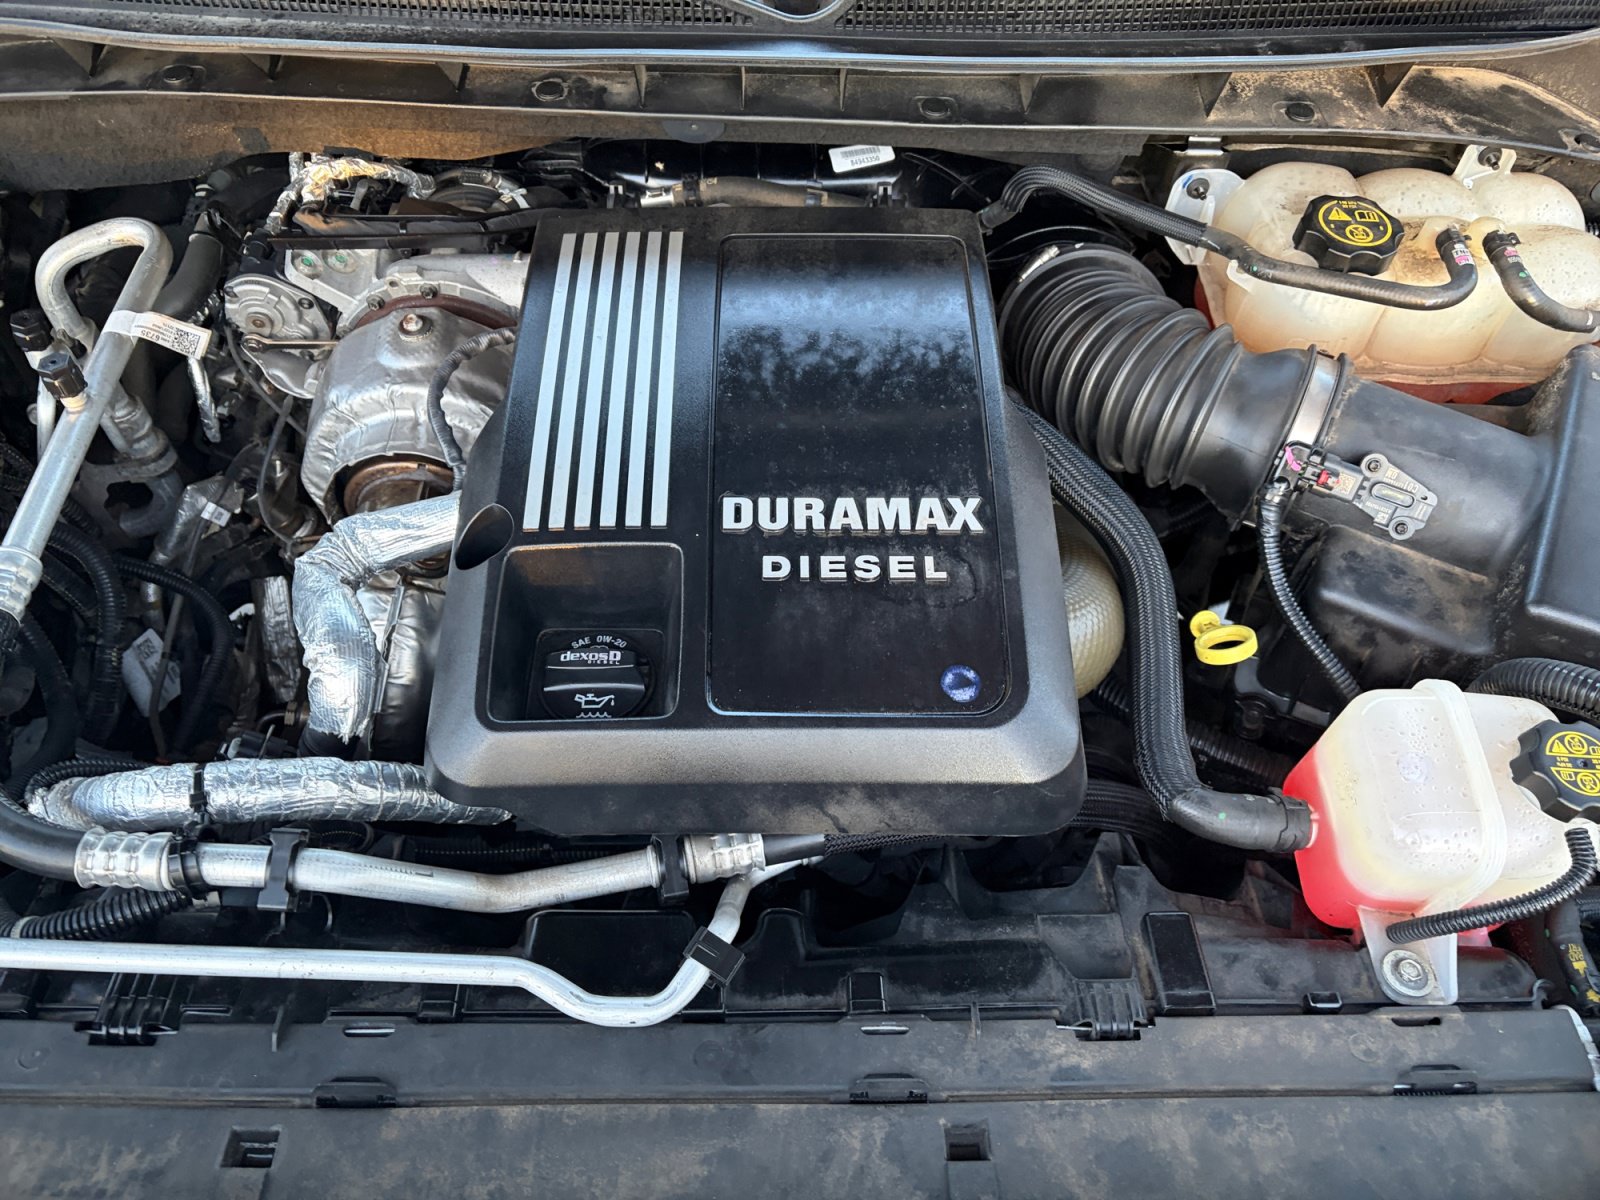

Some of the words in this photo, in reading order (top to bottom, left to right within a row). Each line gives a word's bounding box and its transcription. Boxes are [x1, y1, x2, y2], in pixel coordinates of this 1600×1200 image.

[141, 329, 160, 342] 6735
[720, 496, 984, 534] DURAMAX
[761, 555, 948, 581] DIESEL
[571, 636, 592, 649] SAE
[596, 635, 628, 649] 0W-20
